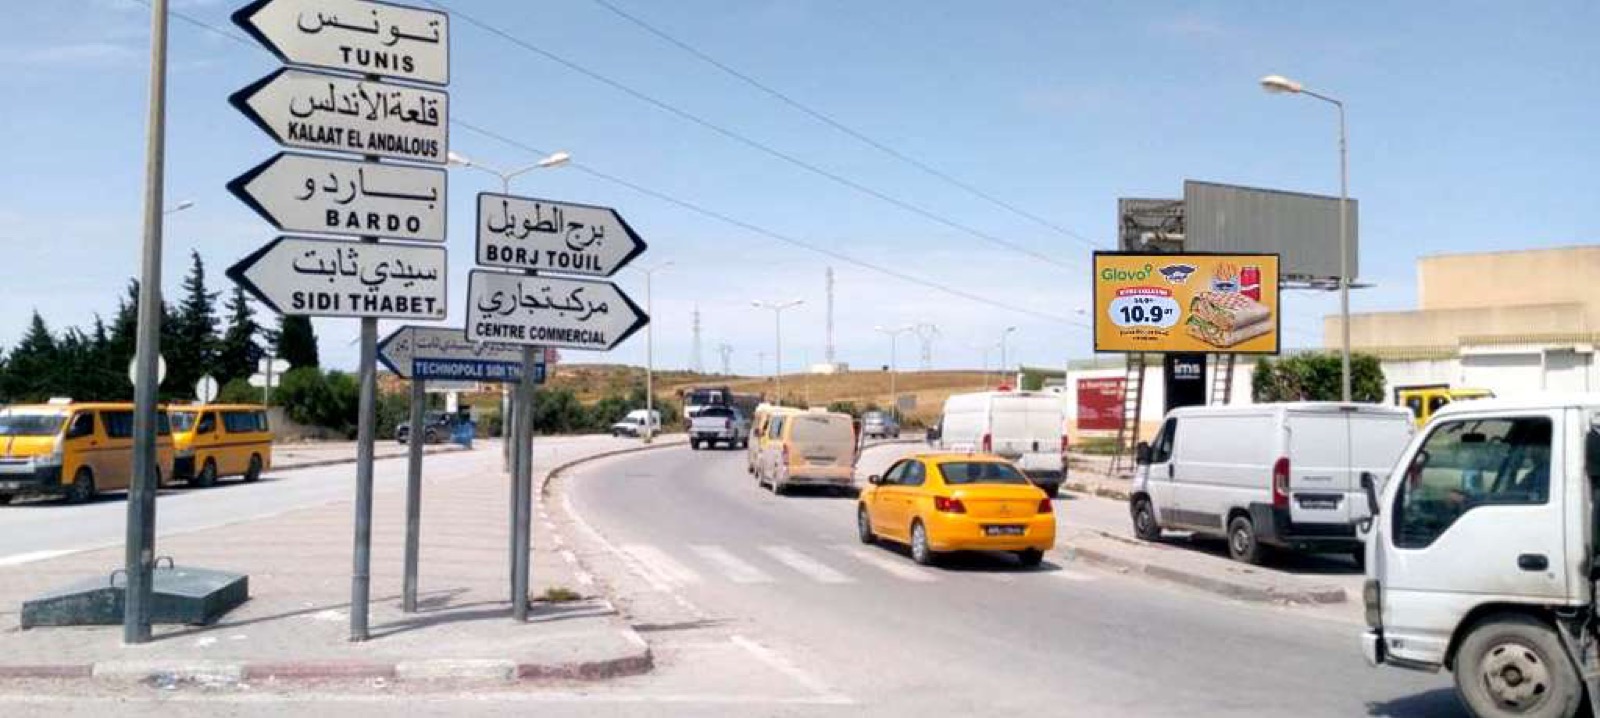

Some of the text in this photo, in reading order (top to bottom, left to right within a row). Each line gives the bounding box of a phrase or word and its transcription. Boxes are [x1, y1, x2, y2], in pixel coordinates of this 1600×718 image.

[297, 9, 439, 46] تونس
[339, 46, 414, 73] TUNIS
[289, 82, 439, 126] قلعة الأندلس
[288, 122, 438, 157] KALAAT EL ANDALOUS
[294, 167, 437, 209] باردو
[326, 209, 420, 233] BARDO
[487, 200, 604, 251] برج الطويل
[292, 247, 437, 292] سيدي ثابت
[487, 245, 602, 271] BORJ TOUIL
[1101, 267, 1147, 281] Glovo
[292, 291, 437, 313] SIDI THABET
[1120, 305, 1163, 323] 10.9
[476, 322, 606, 344] CENTRE COMMERCIAL
[415, 361, 483, 377] TECHNOPOLE
